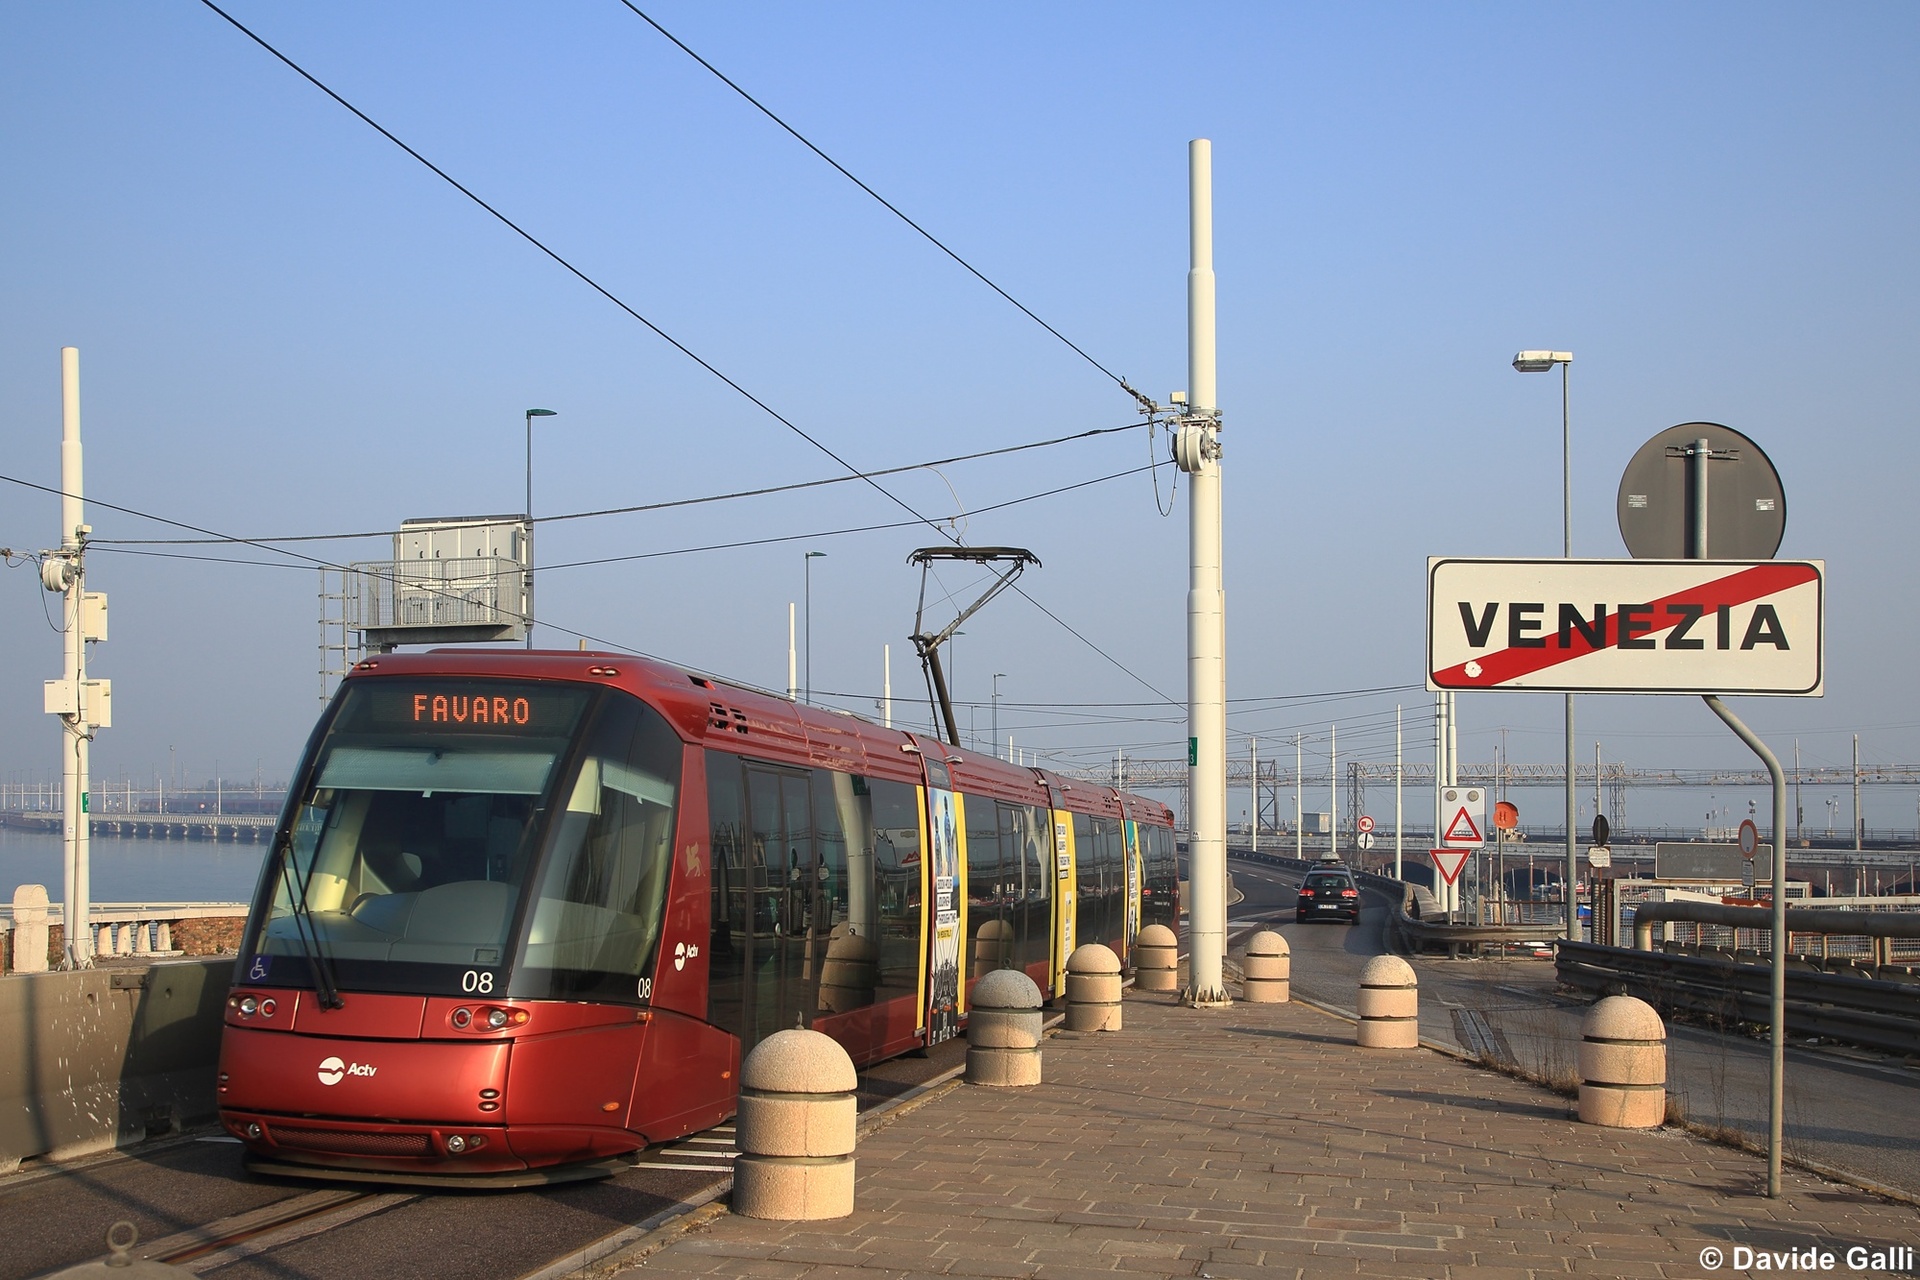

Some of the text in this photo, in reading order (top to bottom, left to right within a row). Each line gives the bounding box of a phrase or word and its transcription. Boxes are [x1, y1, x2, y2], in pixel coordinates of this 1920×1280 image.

[1457, 601, 1791, 651] VENEZIA
[413, 694, 530, 725] FAVARO
[686, 943, 699, 958] Actv
[462, 970, 494, 994] 08
[637, 977, 652, 999] 08
[346, 1061, 378, 1077] Actv
